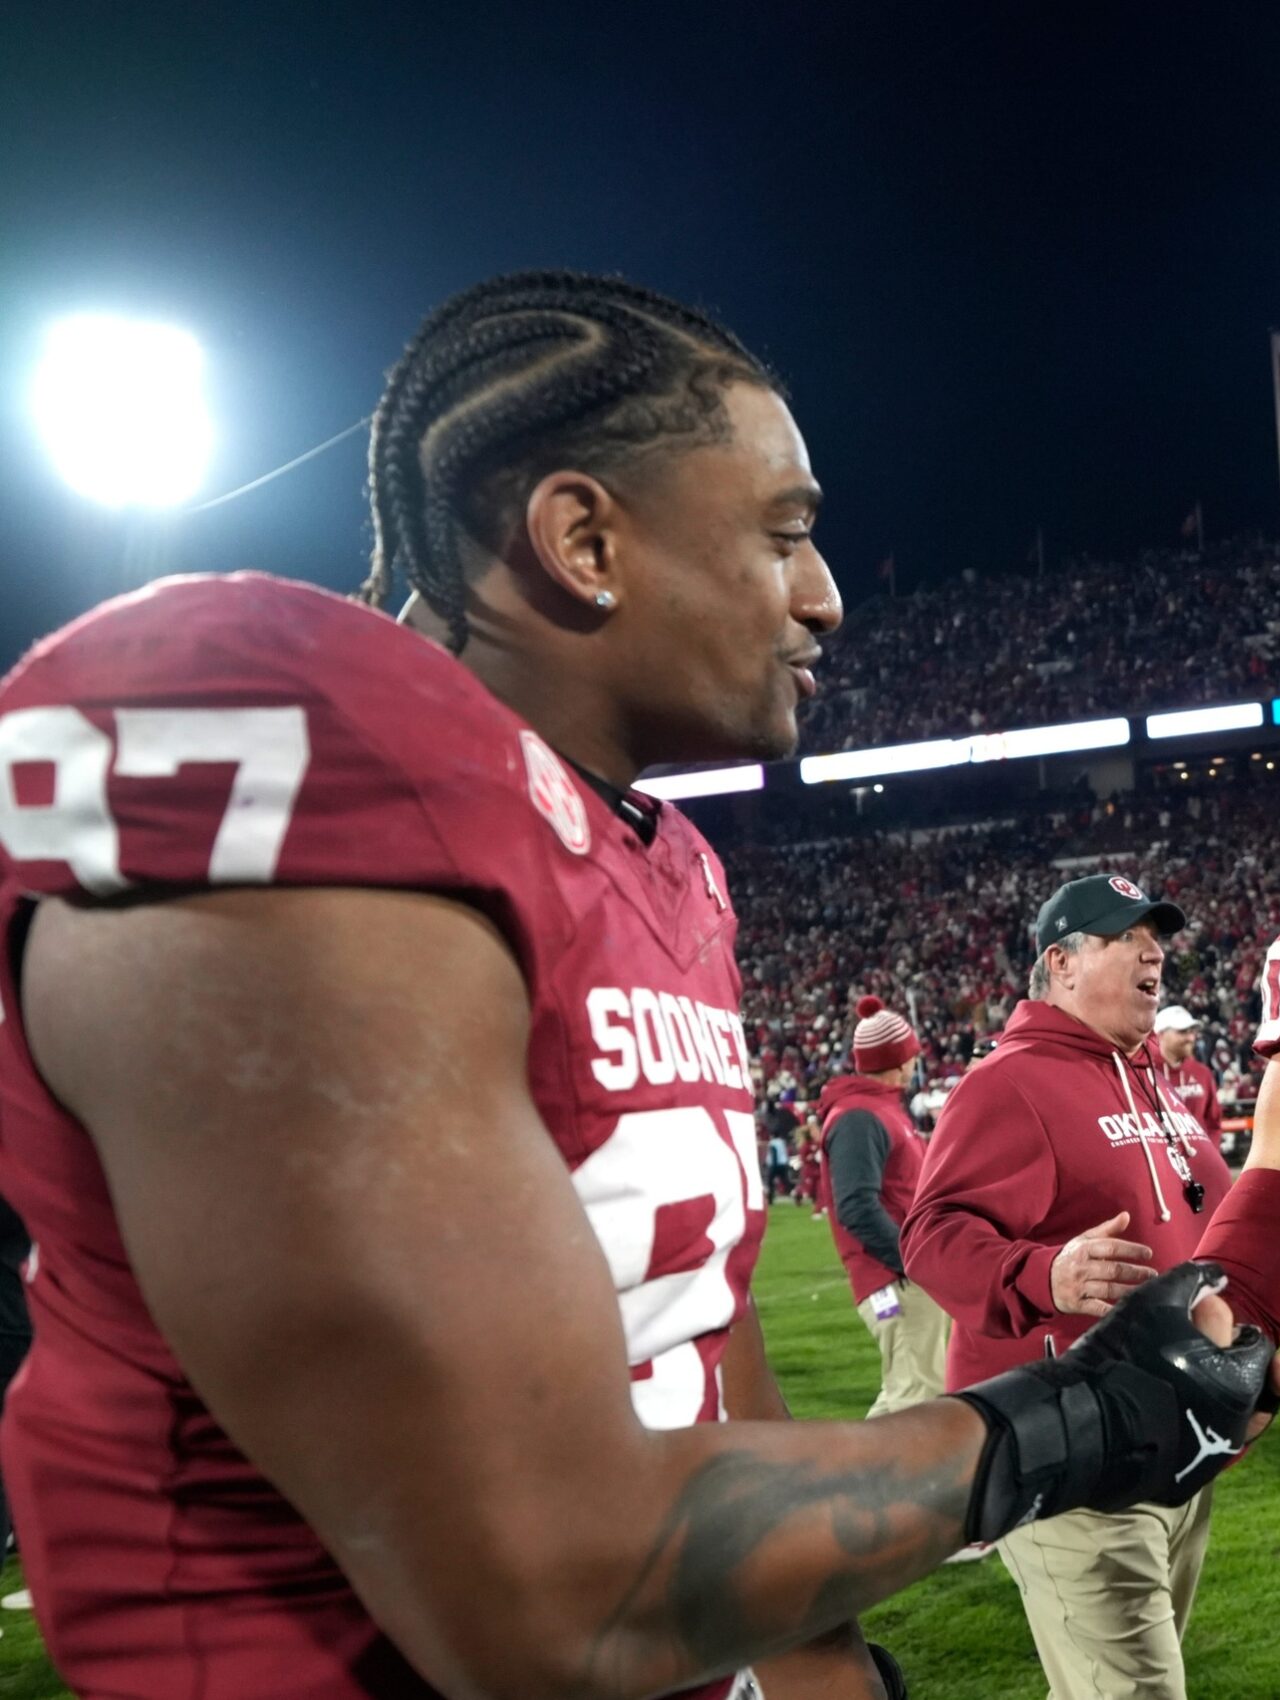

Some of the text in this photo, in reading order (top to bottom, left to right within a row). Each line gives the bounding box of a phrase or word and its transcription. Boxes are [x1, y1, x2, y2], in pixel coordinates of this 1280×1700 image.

[0, 706, 310, 897] 97
[1109, 876, 1142, 900] OU
[586, 987, 754, 1093] SOONER
[1097, 1111, 1207, 1140] OKLAHOM
